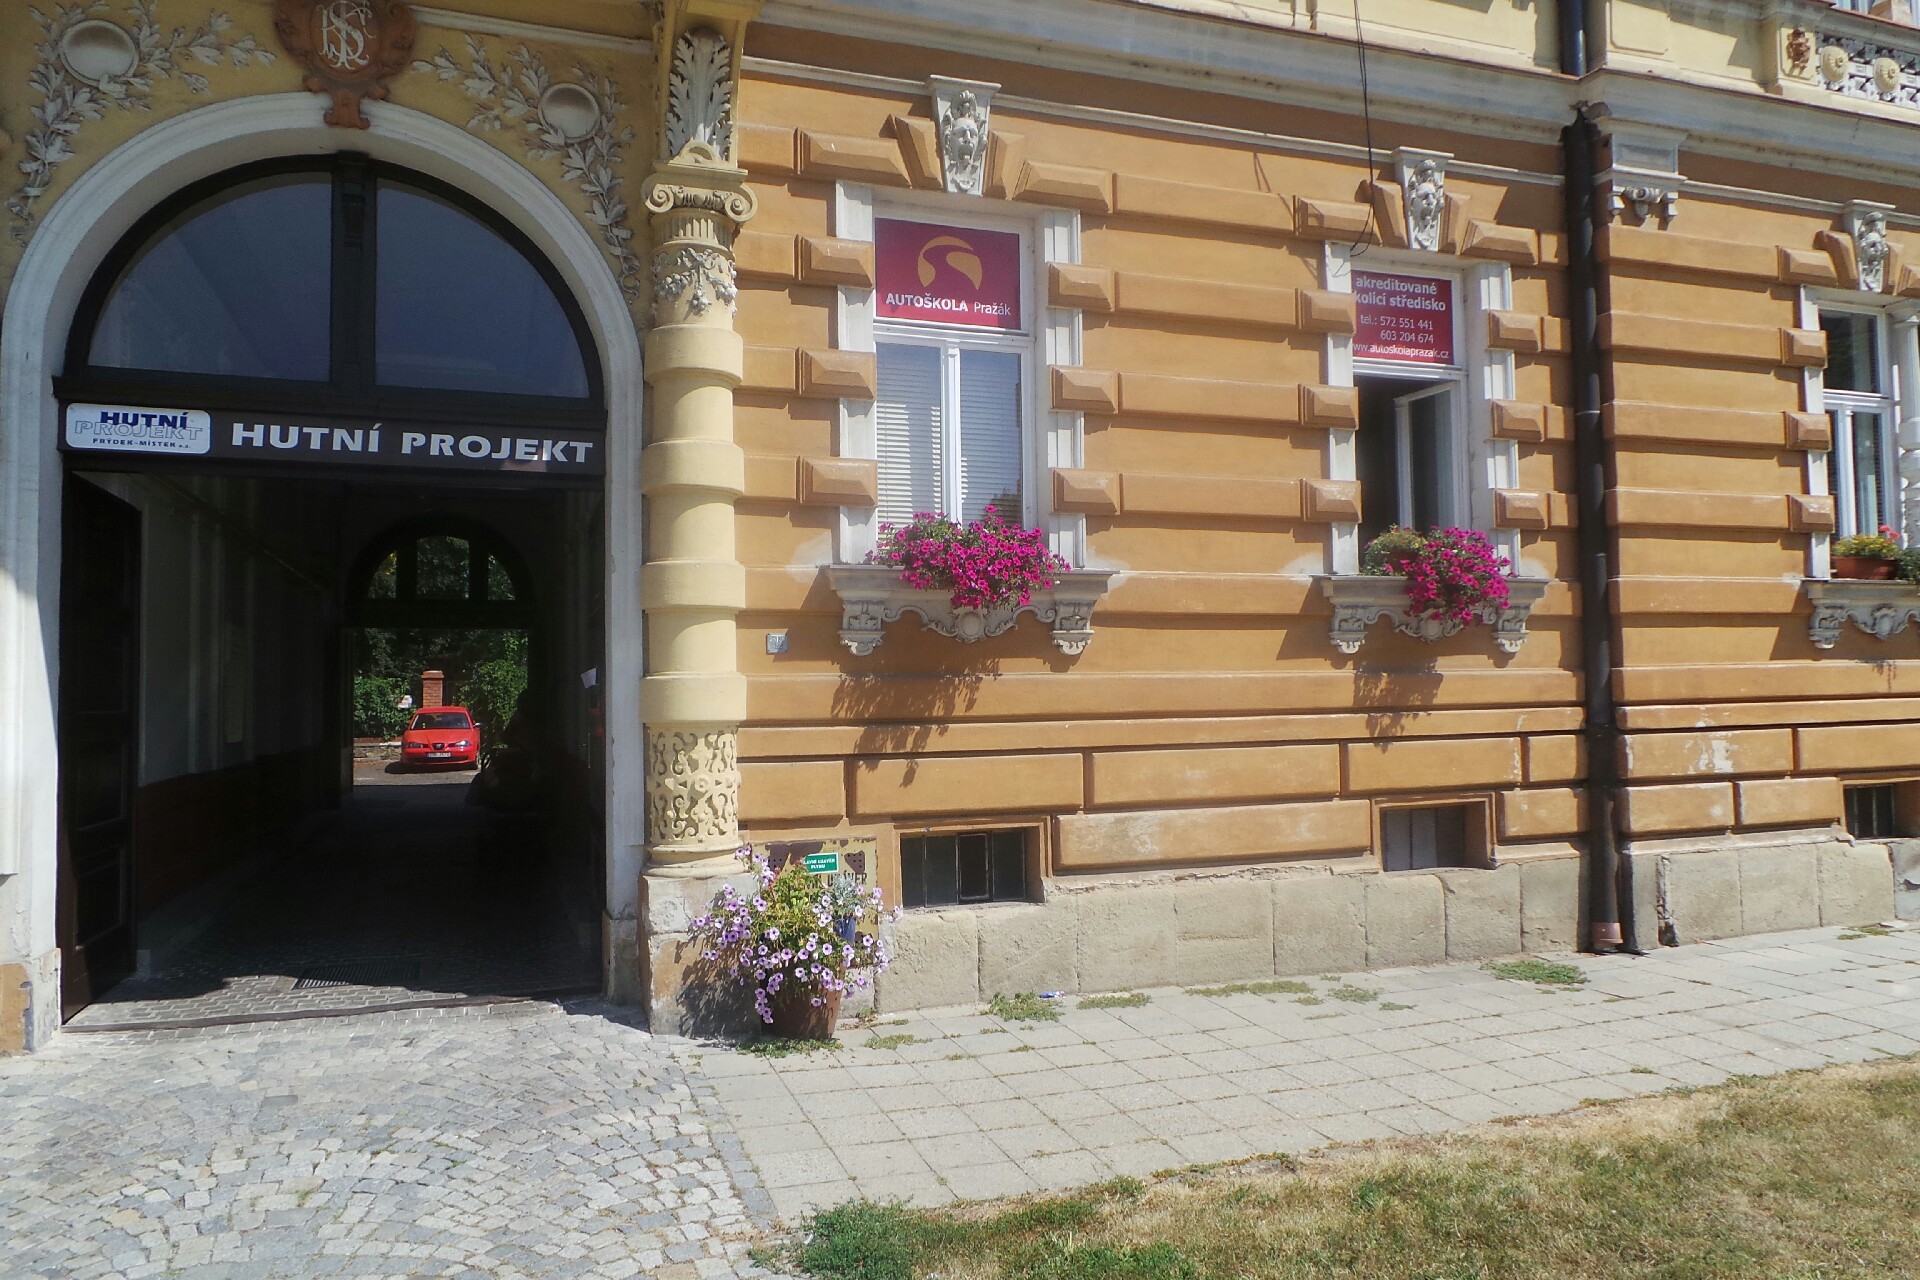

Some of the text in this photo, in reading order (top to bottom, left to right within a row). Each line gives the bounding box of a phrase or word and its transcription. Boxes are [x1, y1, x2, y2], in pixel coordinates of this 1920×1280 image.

[1356, 276, 1437, 294] akreditované
[885, 293, 1011, 316] AUTOŠKOLA Pražák
[1389, 294, 1446, 311] středisko
[1380, 316, 1396, 327] 572
[1399, 318, 1415, 329] 551
[1417, 319, 1433, 330] 441
[1380, 330, 1434, 344] 603 204 674
[101, 411, 188, 429] HUTNÍ
[74, 420, 203, 440] PROJEKT
[231, 422, 594, 463] HUTNÍ PROJEKT
